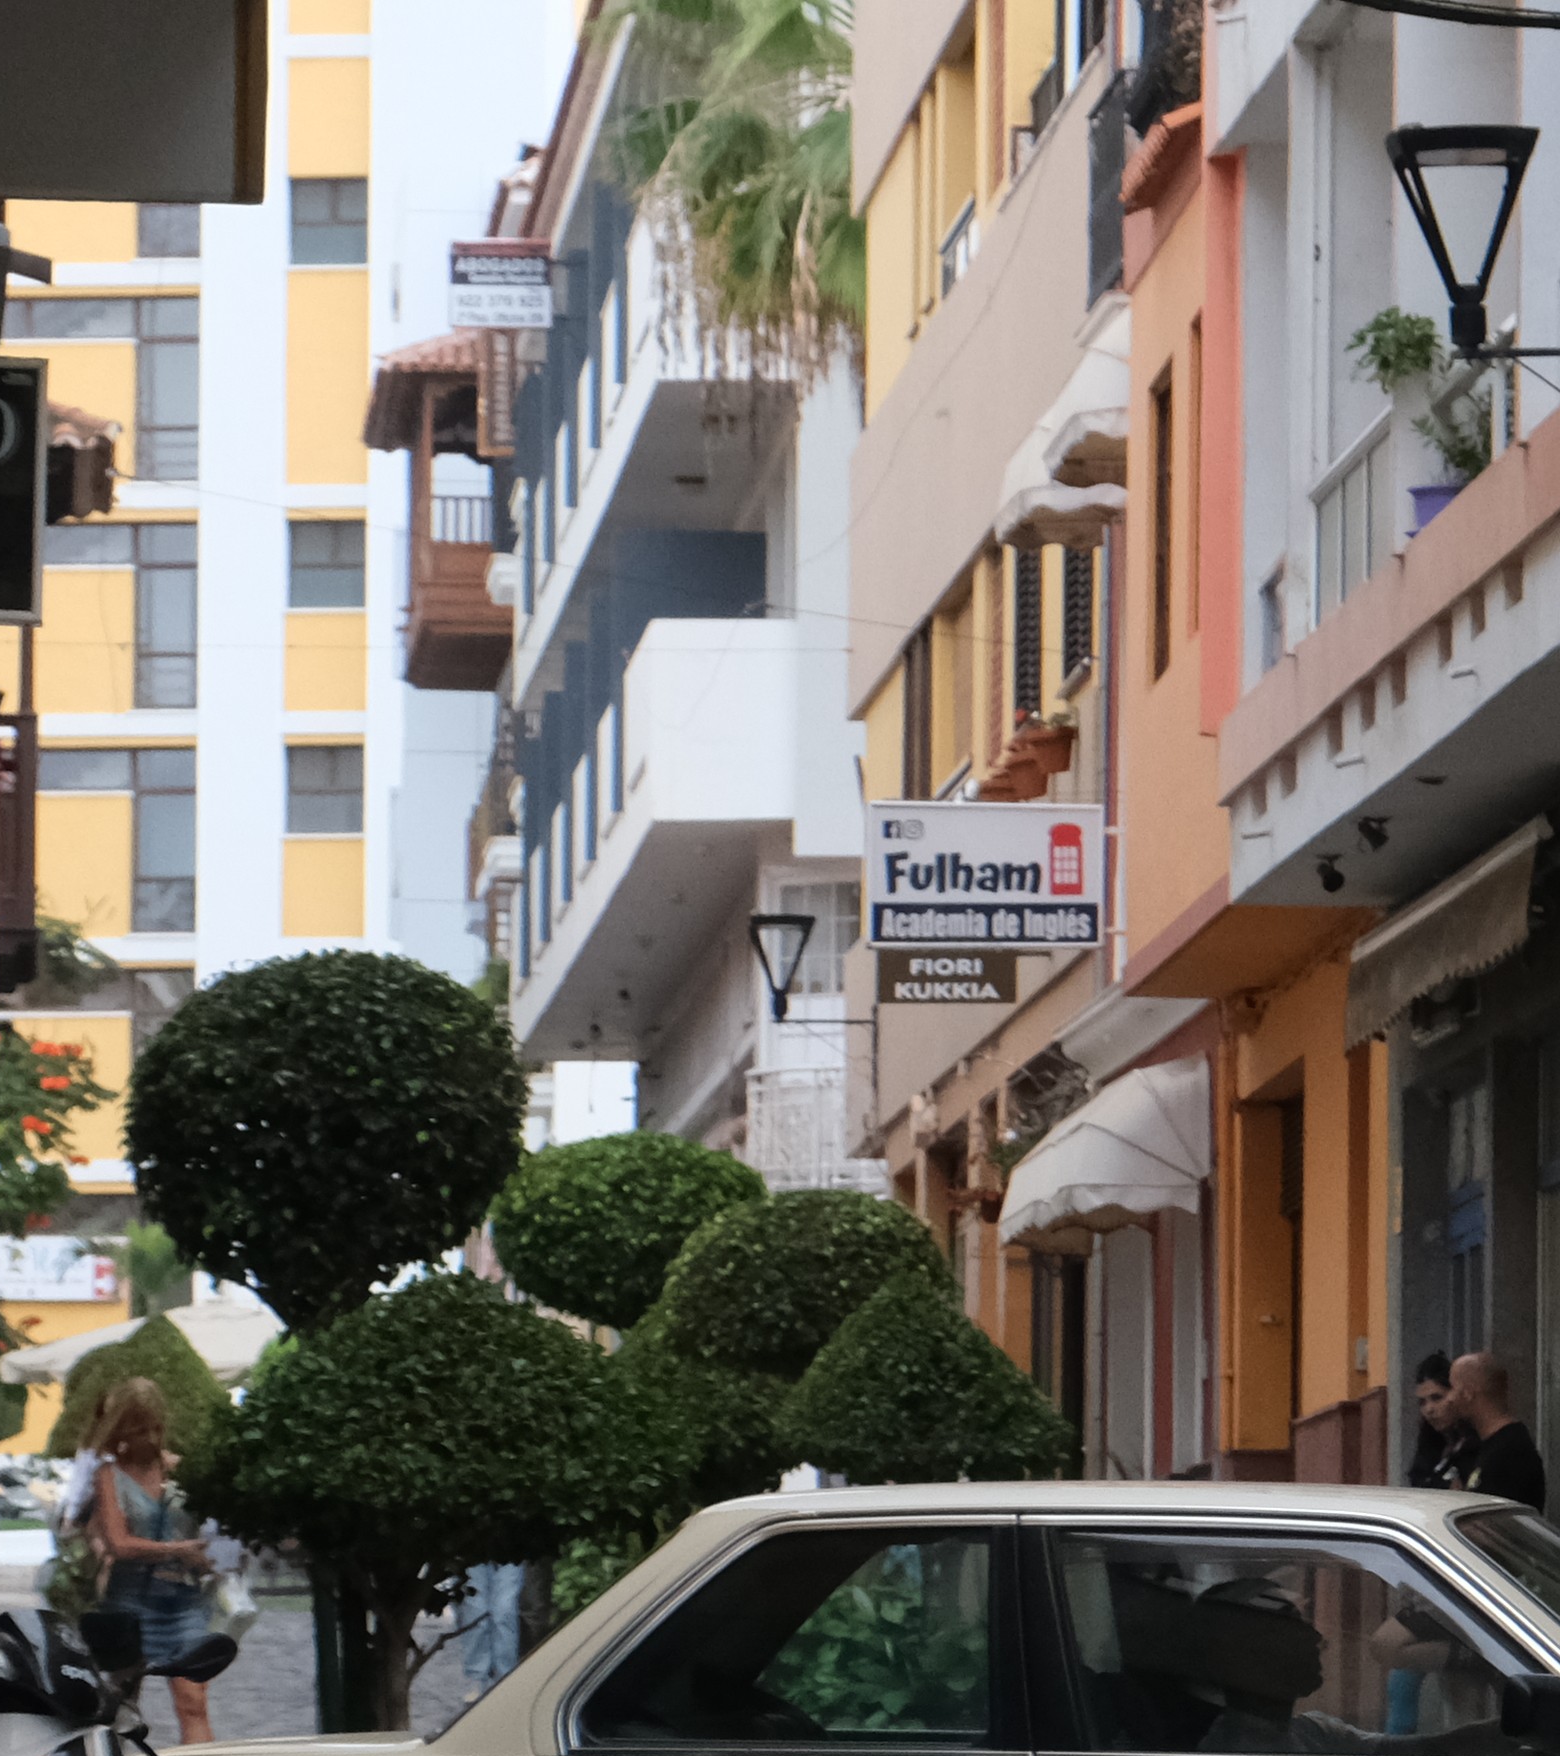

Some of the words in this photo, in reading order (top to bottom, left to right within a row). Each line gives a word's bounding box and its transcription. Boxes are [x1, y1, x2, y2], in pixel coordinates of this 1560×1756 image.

[885, 851, 1042, 893] Fulham
[880, 908, 989, 939] Academia
[992, 909, 1020, 938] de
[1023, 907, 1091, 941] Inglés
[909, 958, 984, 976] FIORI
[894, 981, 1000, 1000] KUKKIA
